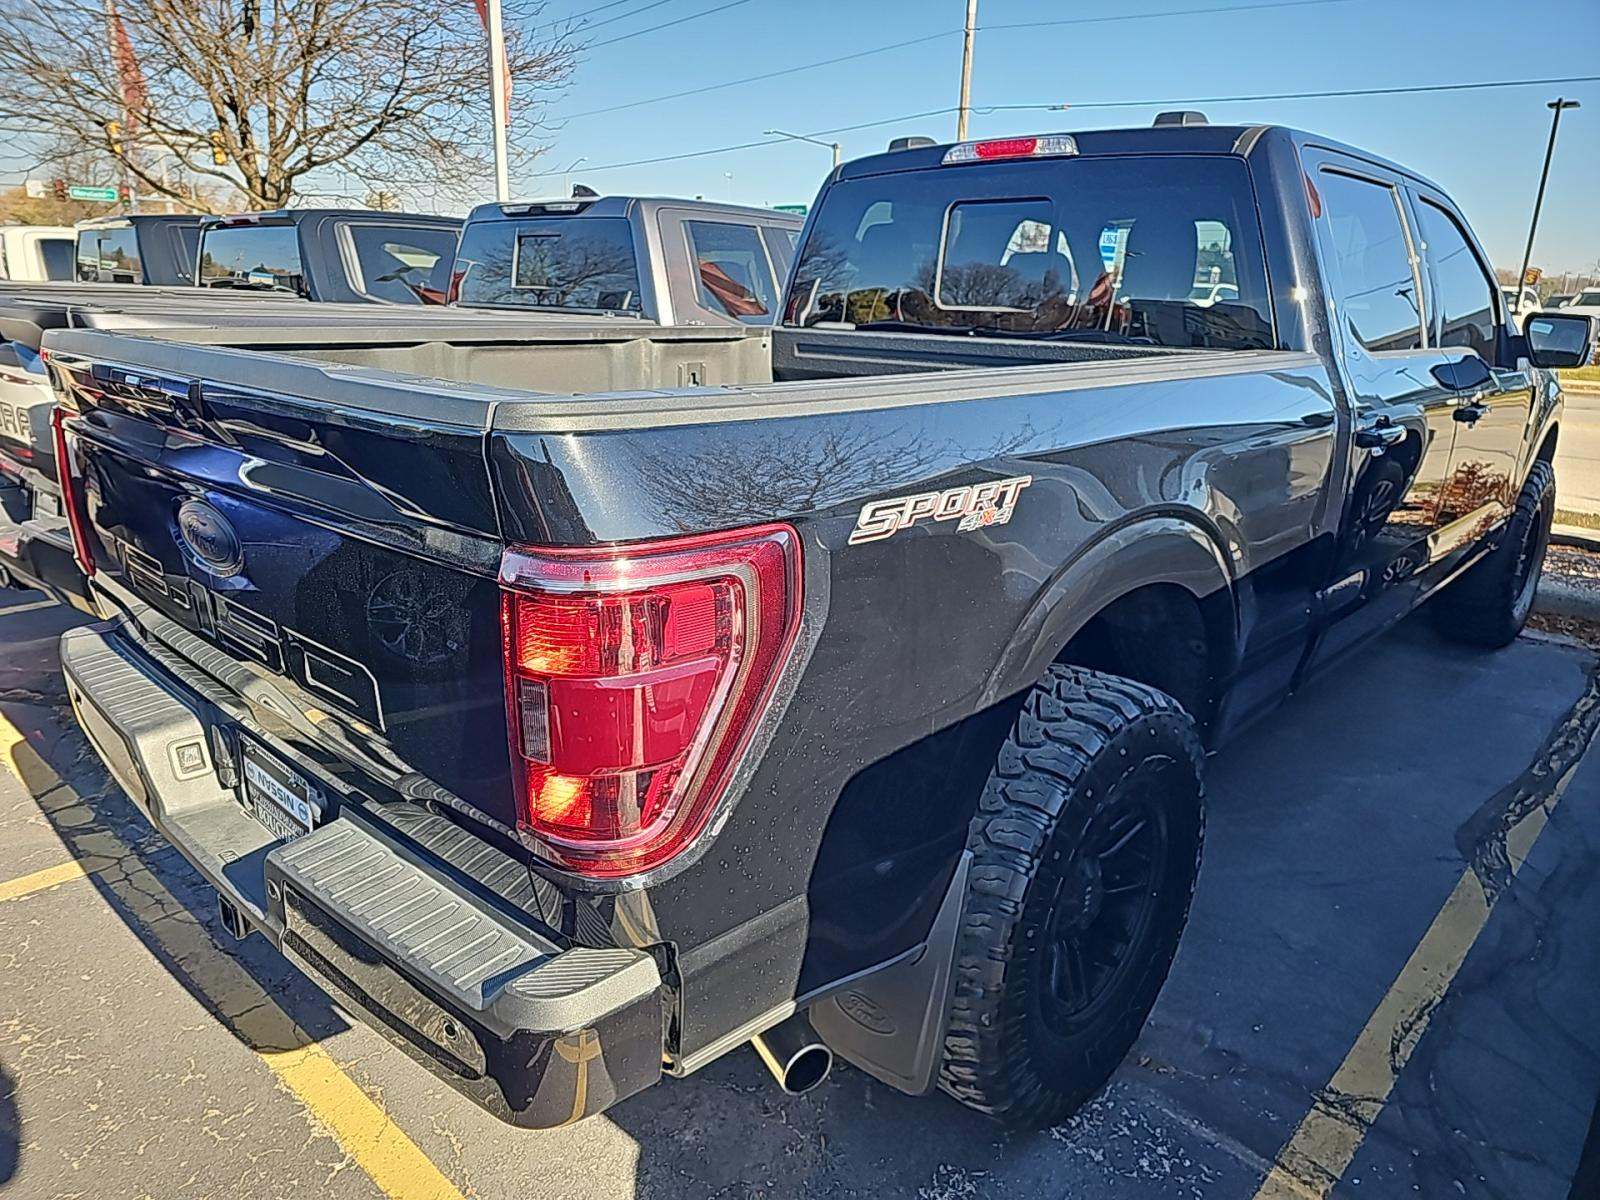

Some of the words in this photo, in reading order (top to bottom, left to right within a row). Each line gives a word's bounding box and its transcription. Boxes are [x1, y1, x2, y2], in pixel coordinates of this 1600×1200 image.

[847, 475, 1033, 545] SPORT
[257, 771, 295, 811] NISSAN
[843, 993, 887, 1029] Ford
